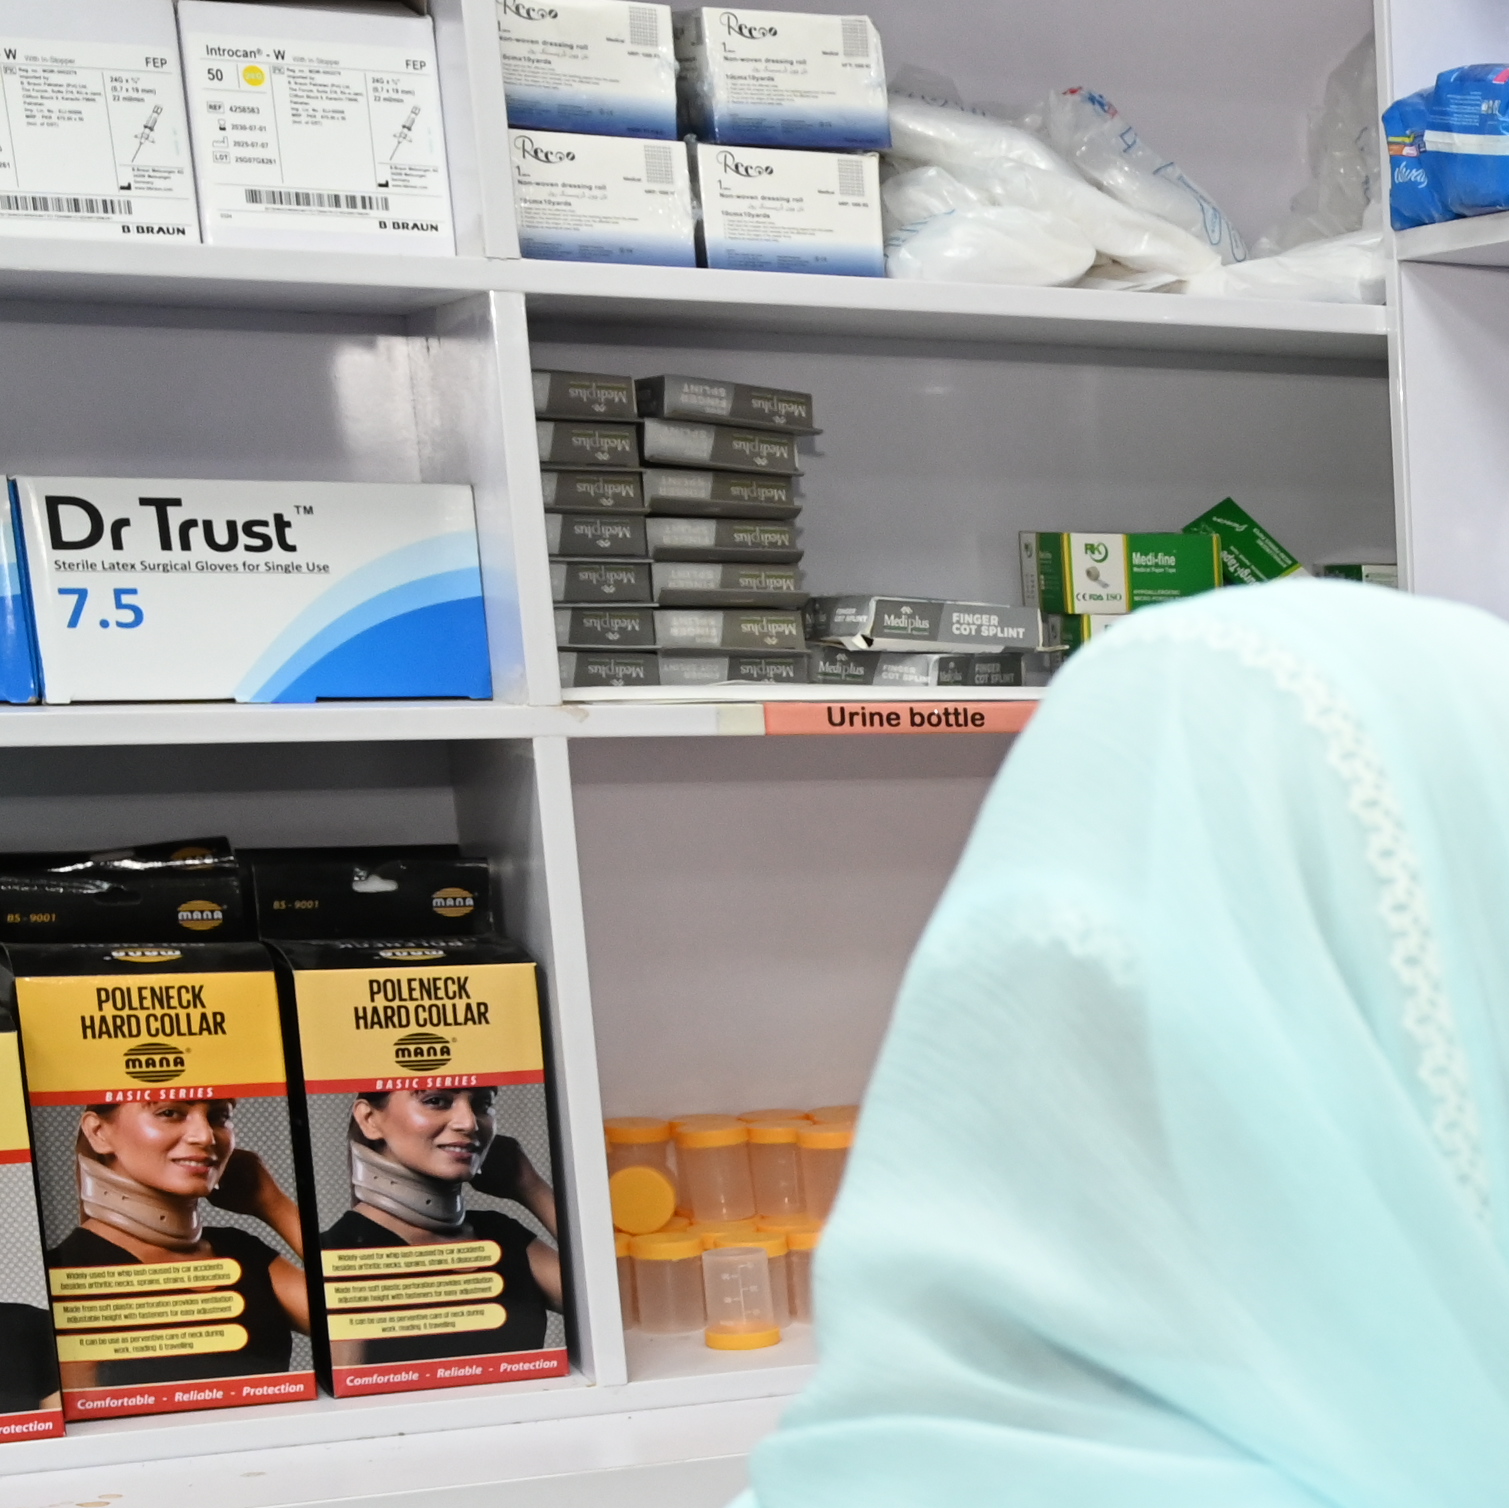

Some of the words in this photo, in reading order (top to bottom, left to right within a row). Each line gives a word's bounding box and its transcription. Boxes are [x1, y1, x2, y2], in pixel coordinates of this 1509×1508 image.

[145, 57, 167, 68] FEP
[274, 50, 286, 61] W
[405, 59, 426, 71] FEP
[207, 68, 224, 82] 50
[215, 153, 228, 162] LOT
[136, 226, 186, 236] BRAUN
[392, 221, 439, 231] BRAUN
[569, 383, 627, 404] Mediplus
[752, 393, 807, 418] Mediplus
[572, 431, 630, 453] Mediplus
[732, 434, 788, 458] Mediplus
[576, 478, 634, 499] Mediplus
[731, 481, 786, 502] Mediplus
[44, 495, 131, 551] Dr
[575, 520, 631, 539] Mediplus
[734, 527, 790, 547] Mediplus
[54, 559, 97, 572] Sterile
[101, 560, 136, 571] Latex
[140, 560, 191, 574] Surgical
[195, 561, 239, 572] Gloves
[242, 560, 260, 572] for
[264, 561, 303, 574] Single
[306, 562, 330, 573] Use
[1132, 552, 1176, 566] Medi-fine
[579, 566, 635, 585] Mediplus
[739, 573, 794, 592] Mediplus
[1106, 593, 1122, 601] ISO
[57, 587, 145, 629] 7.5
[583, 613, 640, 632] Mediplus
[741, 618, 797, 637] Mediplus
[884, 613, 930, 634] Mediplus
[952, 612, 999, 626] FINGER
[952, 624, 977, 636] COT
[981, 626, 1026, 639] SPLINT
[588, 660, 644, 679] Mediplus
[740, 660, 794, 678] Mediplus
[818, 660, 864, 681] Mediplus
[882, 664, 916, 674] FINGER
[974, 674, 991, 684] COT
[993, 673, 1015, 684] SPLINT
[827, 706, 900, 727] Urine
[909, 706, 985, 728] bottle
[295, 900, 319, 910] 9001
[29, 913, 56, 924] 9001
[96, 984, 206, 1011] POLENECK
[368, 977, 470, 1003] POLENECK
[80, 1013, 142, 1040] HARD
[146, 1011, 226, 1038] COLLAR
[354, 1004, 411, 1030] HARD
[414, 1002, 491, 1028] COLLAR
[376, 1077, 422, 1091] BASIC
[427, 1075, 478, 1088] SERIES
[105, 1088, 155, 1102] BASIC
[159, 1086, 214, 1100] SERIES
[346, 1371, 419, 1387] Comfortable
[437, 1365, 482, 1378] Reliable
[500, 1359, 558, 1372] Protection
[77, 1394, 155, 1410] Comfortable
[175, 1388, 223, 1402] Reliable
[242, 1382, 304, 1397] Protection
[0, 1420, 53, 1435] rotection
